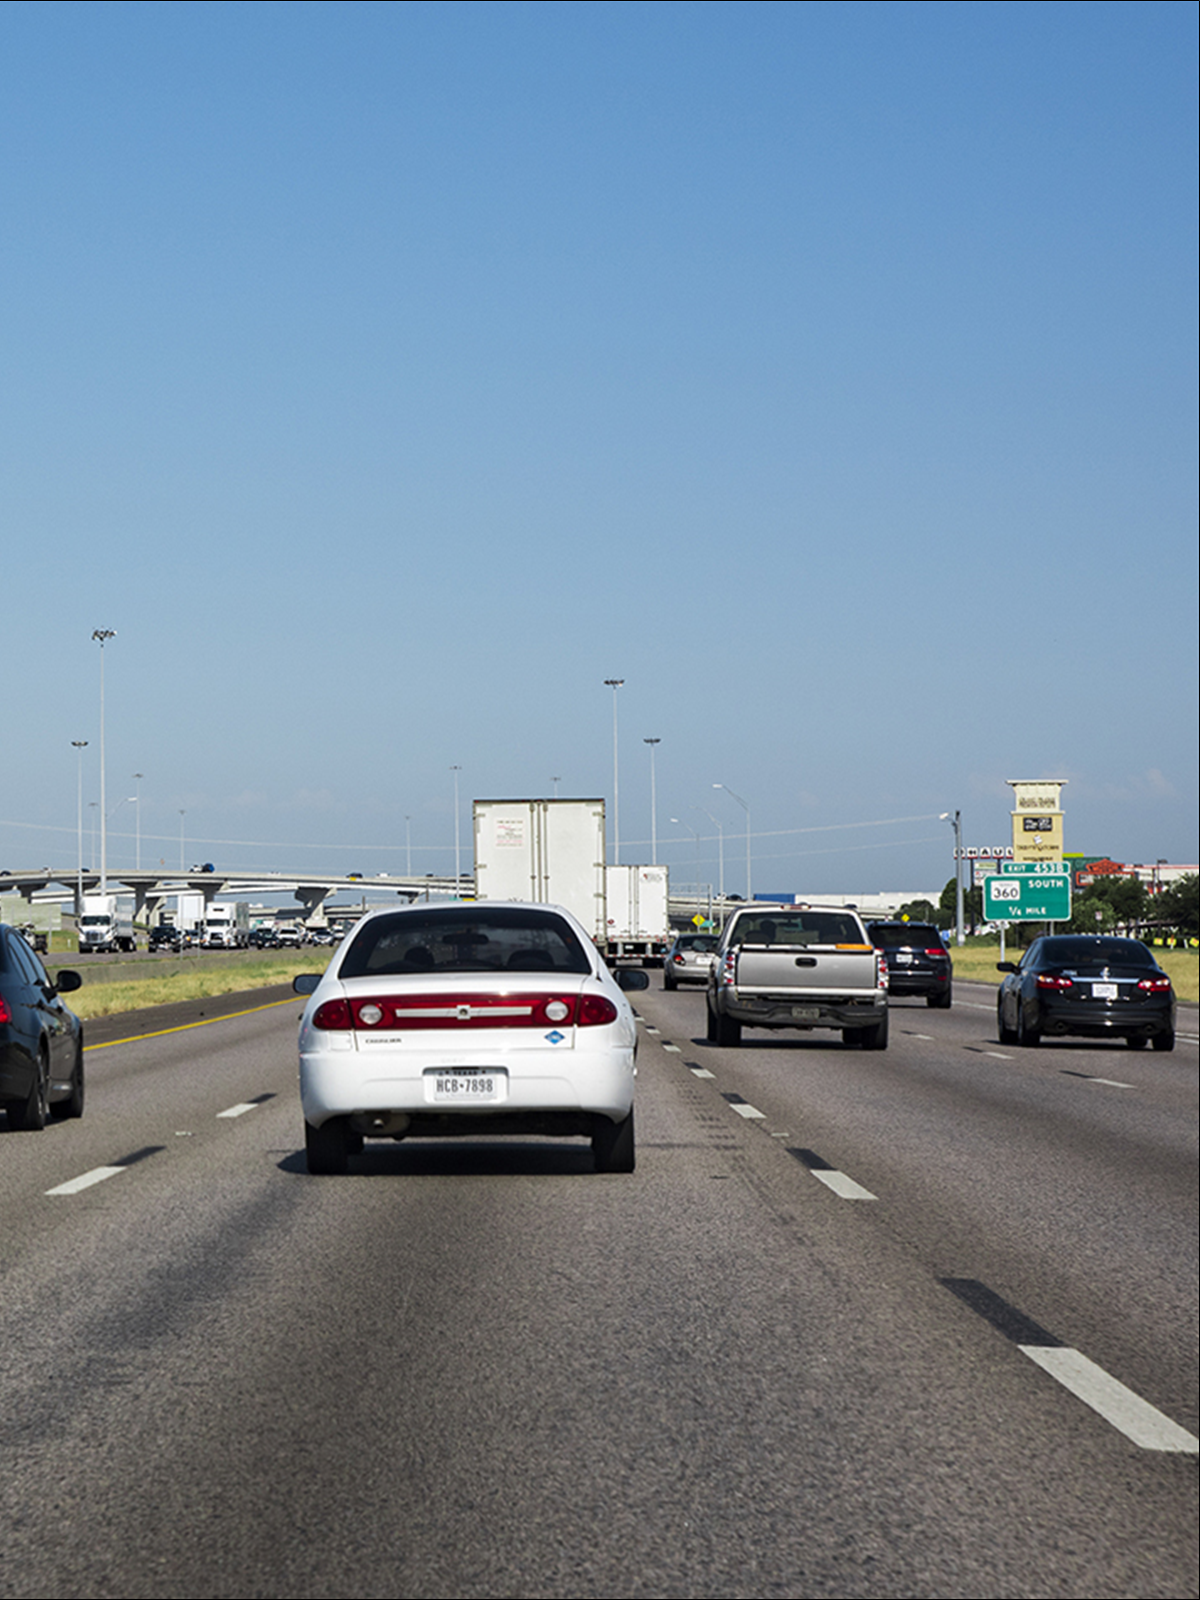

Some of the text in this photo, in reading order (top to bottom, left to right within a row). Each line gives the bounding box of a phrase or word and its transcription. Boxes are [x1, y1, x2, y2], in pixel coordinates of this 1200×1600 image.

[1028, 879, 1064, 888] SOUTH
[993, 887, 1019, 899] 360
[1025, 907, 1047, 915] MILE
